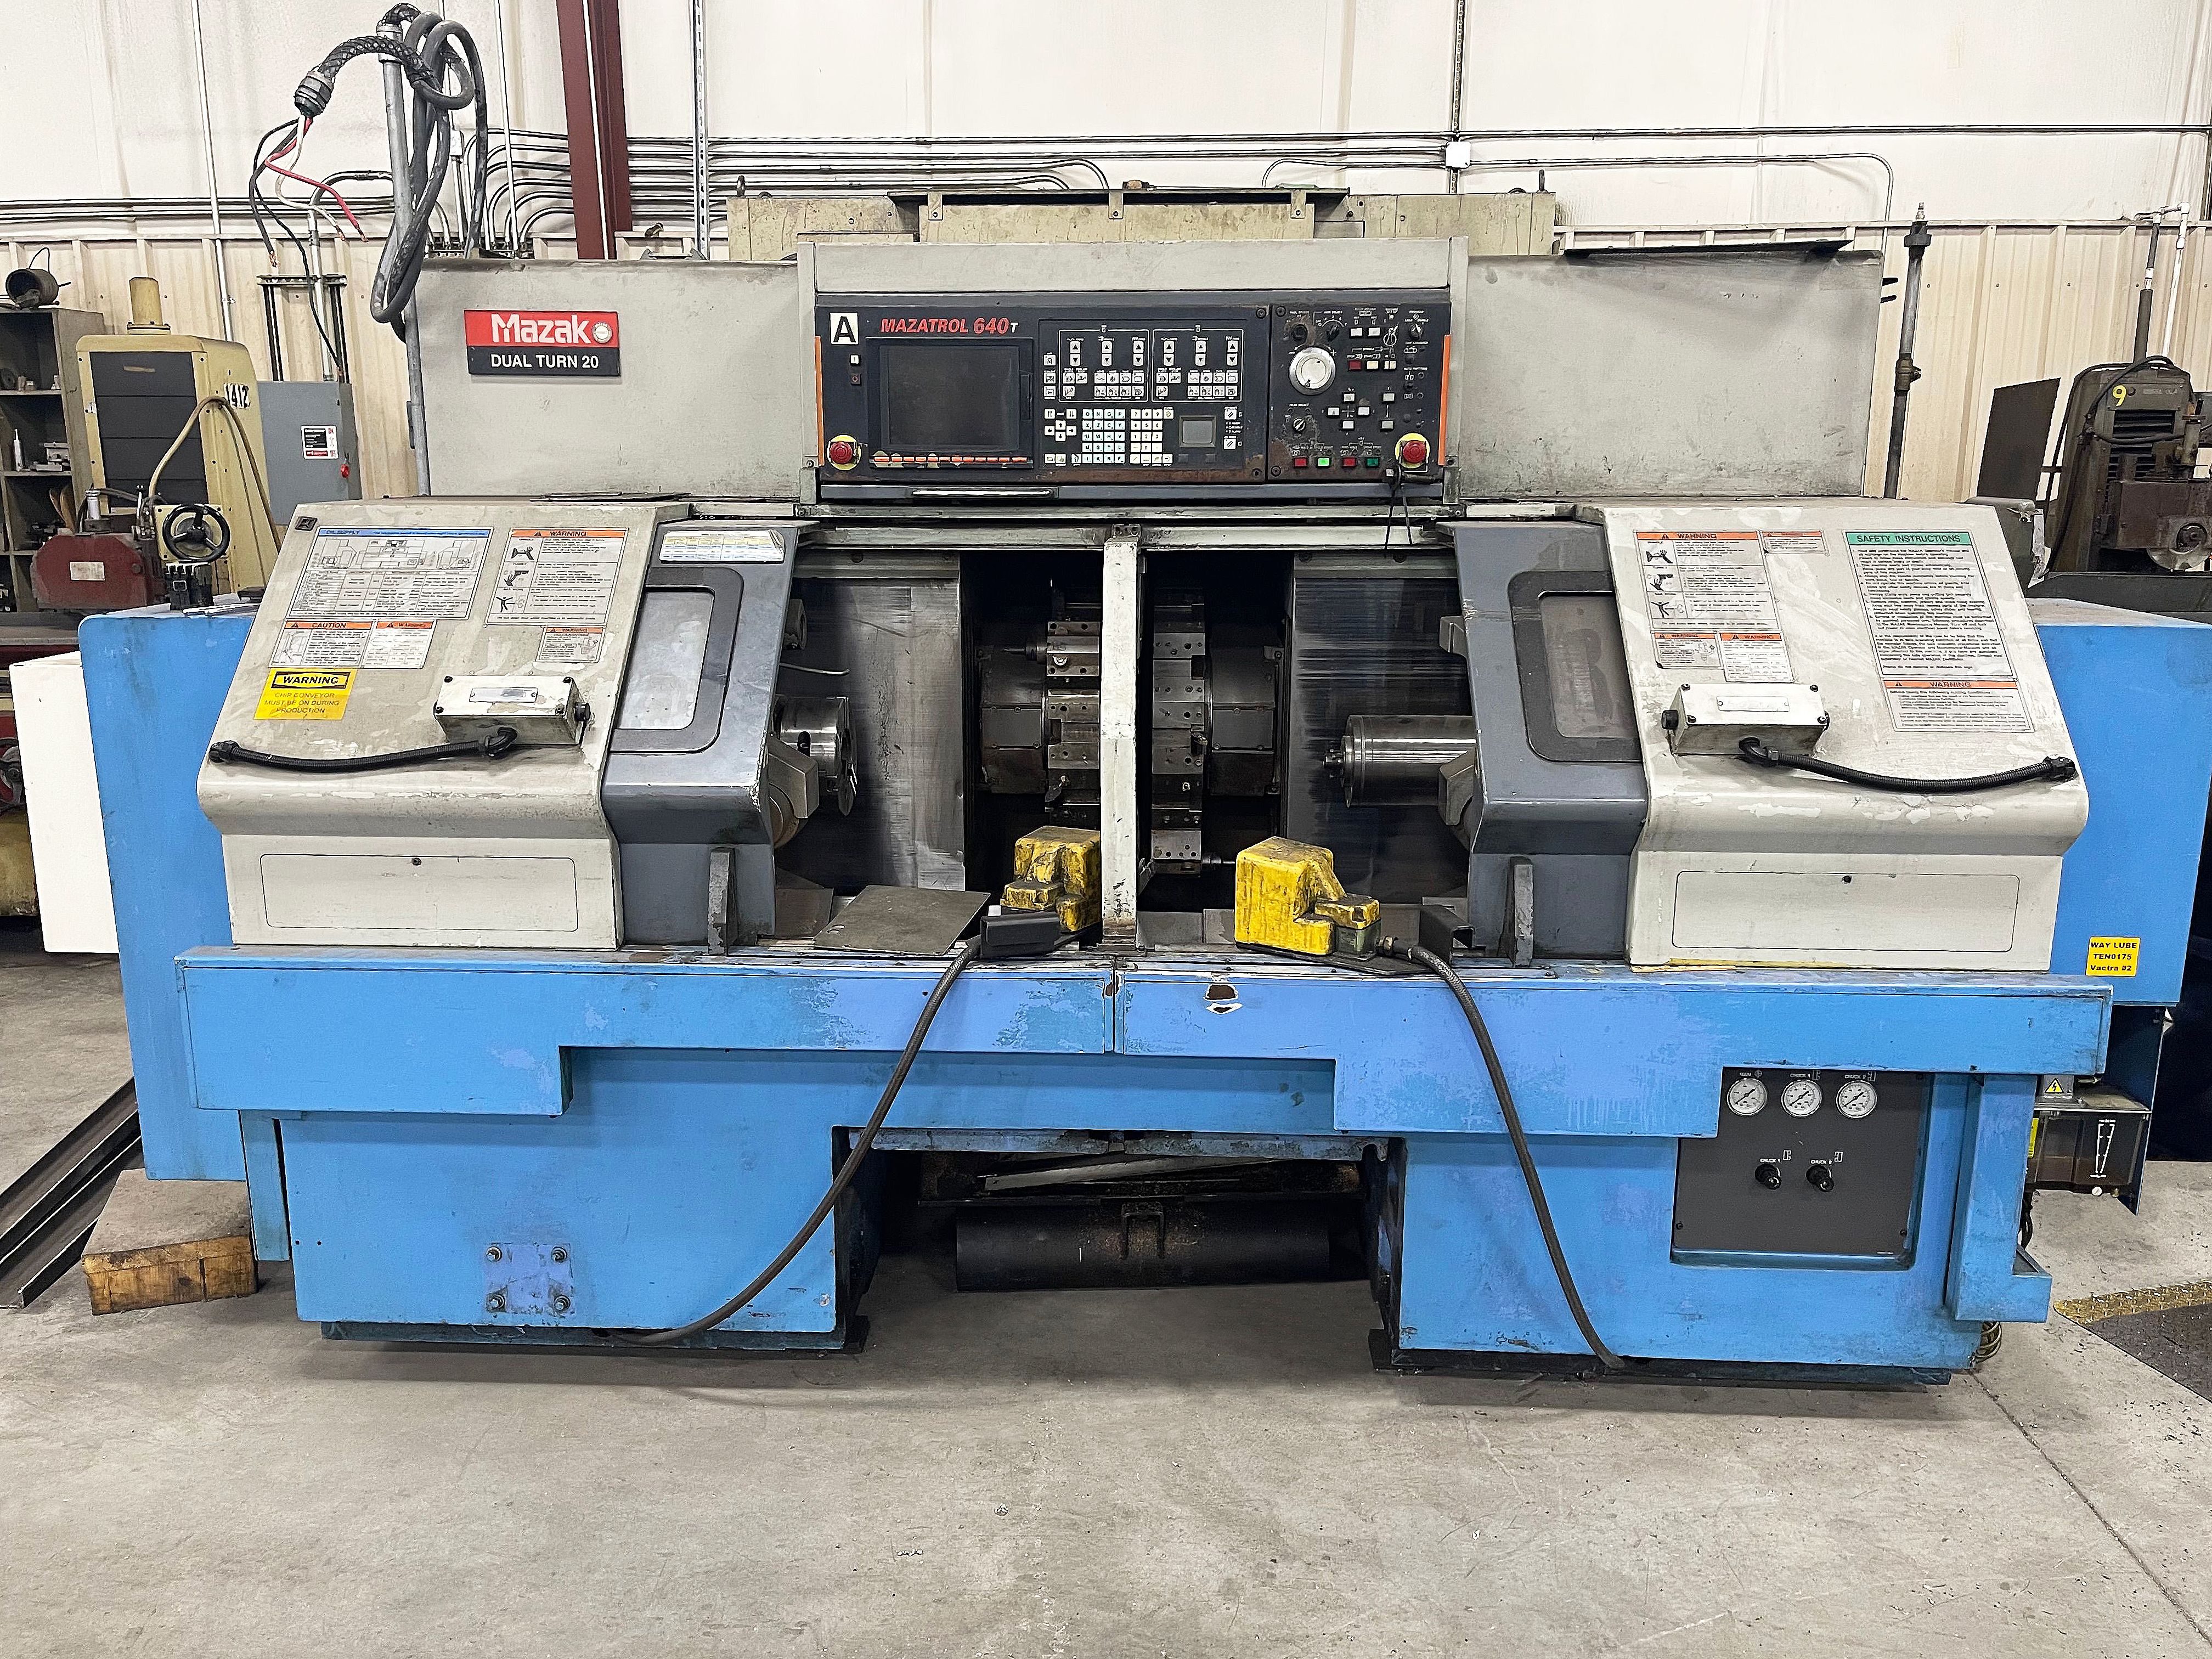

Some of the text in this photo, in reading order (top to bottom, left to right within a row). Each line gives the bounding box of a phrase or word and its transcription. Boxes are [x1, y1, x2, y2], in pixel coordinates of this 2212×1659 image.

[490, 313, 592, 344] Mazak
[833, 315, 856, 343] A
[880, 318, 969, 333] MAZATROL
[490, 354, 599, 369] DUAL TURN 20
[2112, 385, 2126, 407] 9
[283, 676, 339, 684] WARNING
